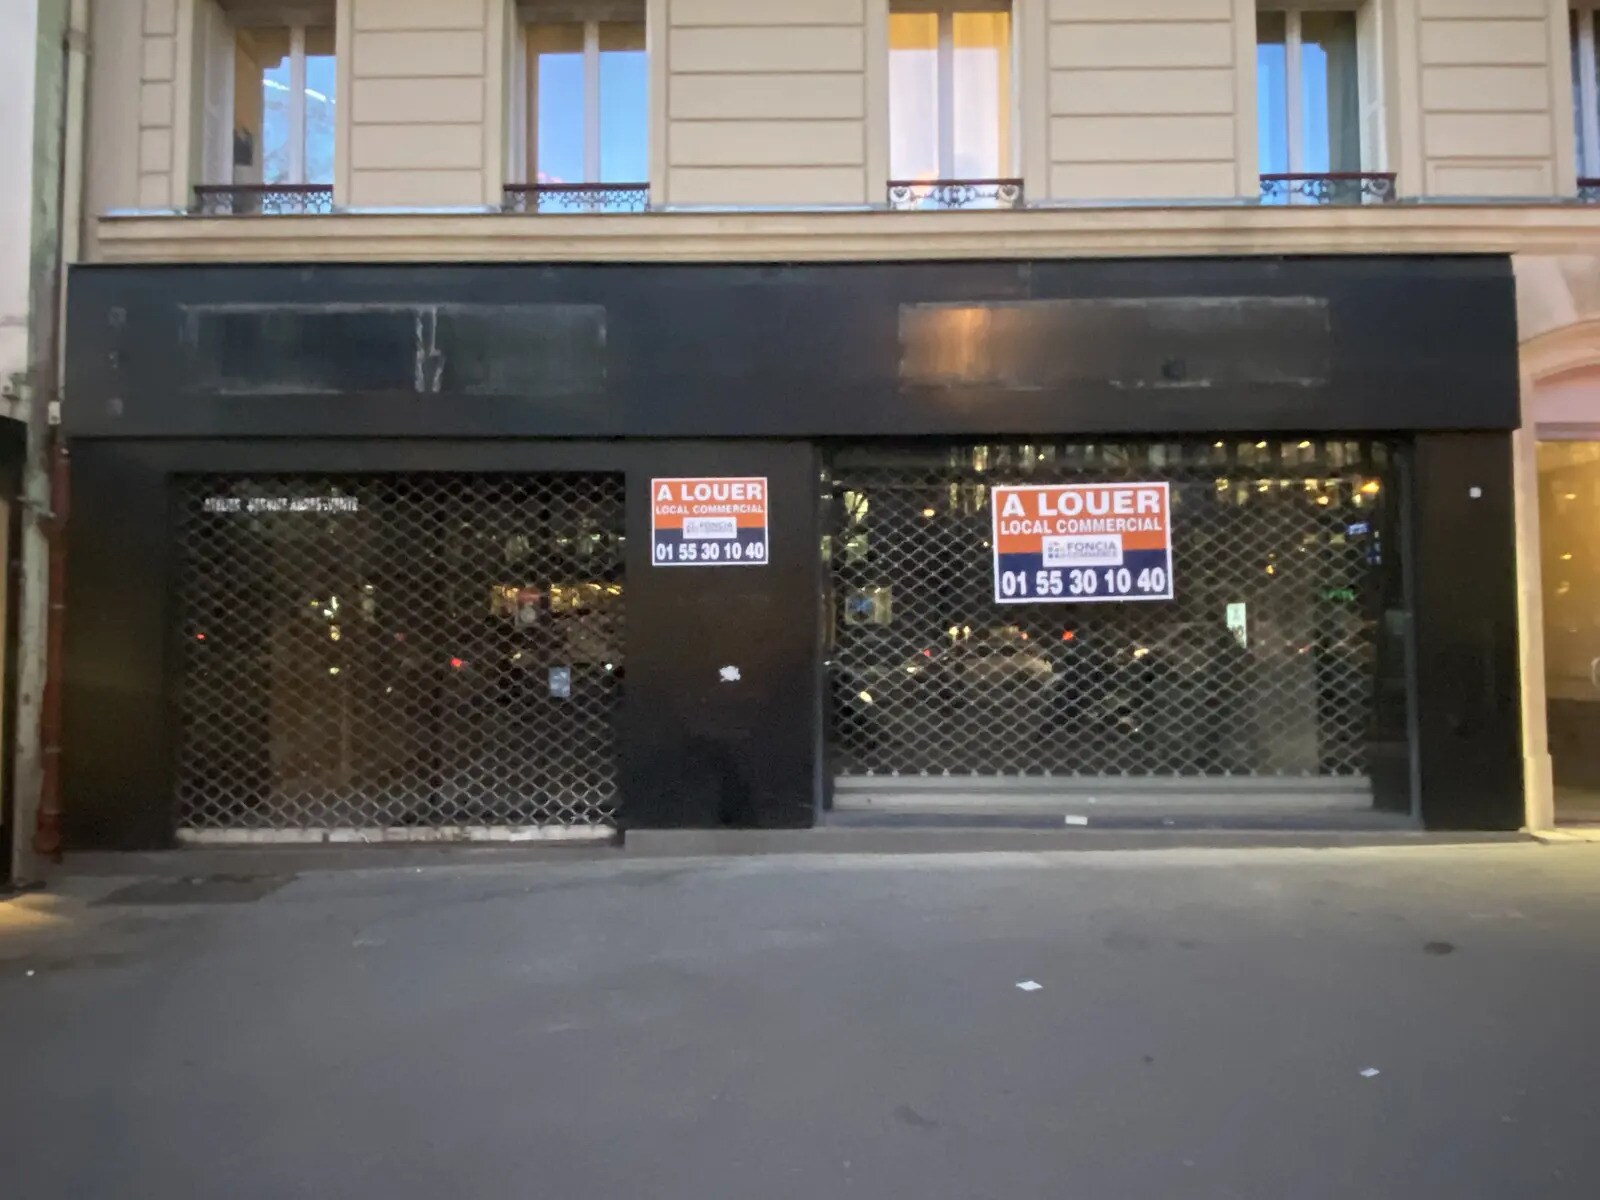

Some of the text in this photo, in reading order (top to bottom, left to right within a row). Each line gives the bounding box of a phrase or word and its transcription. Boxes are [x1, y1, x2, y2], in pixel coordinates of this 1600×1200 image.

[657, 483, 763, 501] A LOUER
[655, 504, 764, 514] LOCAL COMMERCIAL
[1002, 490, 1160, 517] A LOUER
[1000, 517, 1162, 535] LOCAL COMMERCIAL
[656, 542, 764, 560] 01 55 30 10 40
[1067, 541, 1117, 552] FONCIA
[1002, 567, 1166, 596] 01 55 30 10 40
